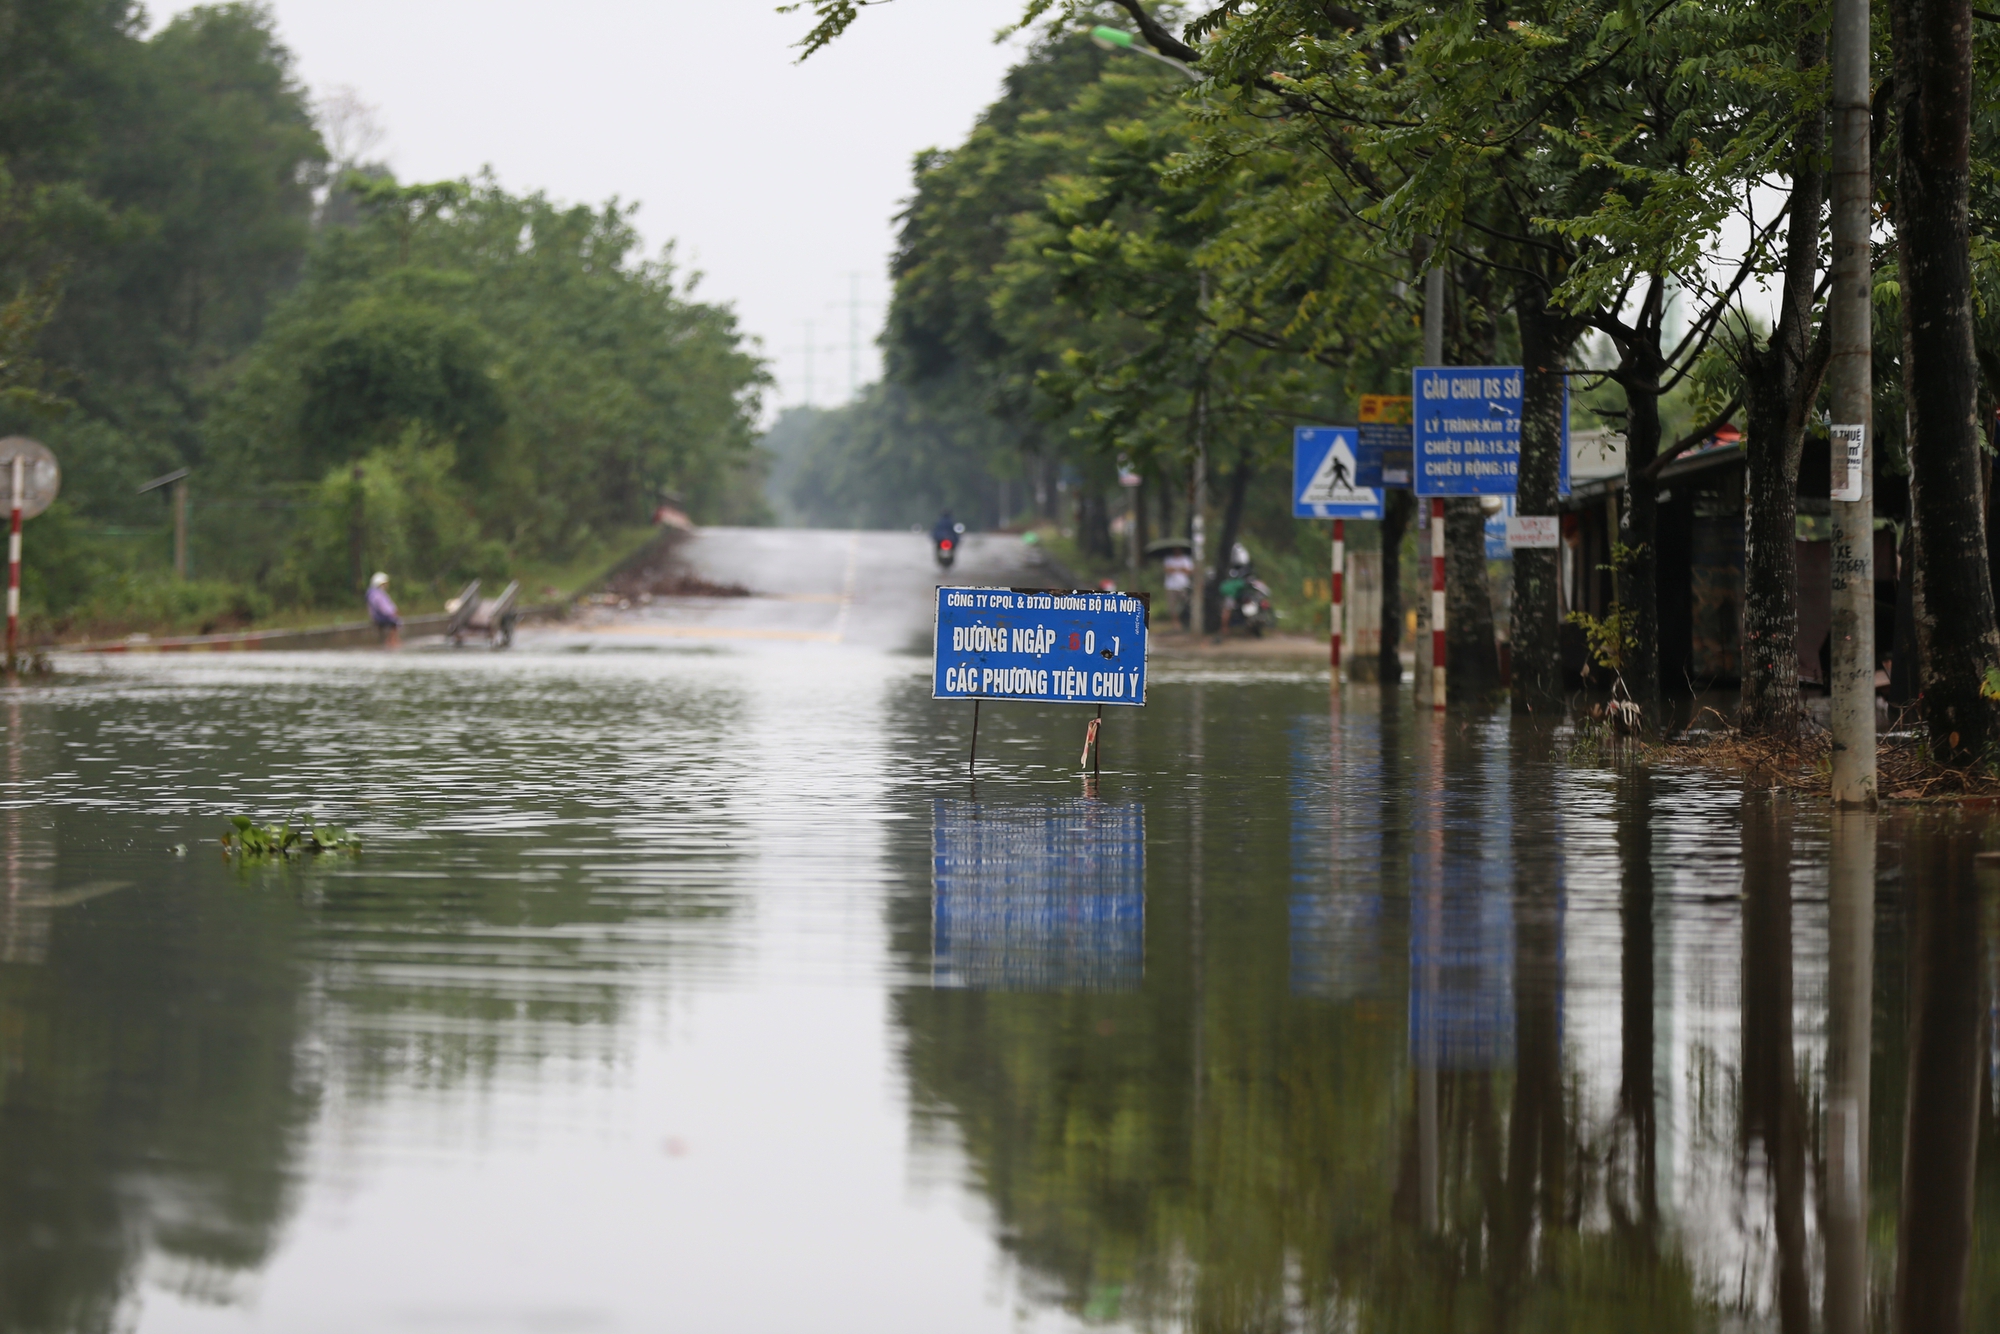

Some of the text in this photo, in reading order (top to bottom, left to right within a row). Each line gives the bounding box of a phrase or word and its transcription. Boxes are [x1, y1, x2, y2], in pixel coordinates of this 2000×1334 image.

[947, 591, 974, 607] CÔNG
[976, 594, 987, 607] TY
[990, 595, 1014, 609] CPQL
[1017, 597, 1025, 608] &
[1026, 597, 1051, 609] ĐTXD
[1088, 597, 1102, 614] BỘ
[1104, 596, 1117, 613] HÀ
[1119, 597, 1137, 615] NỘI
[953, 619, 1007, 651] ĐƯỜNG
[1012, 624, 1057, 658] NGẬP
[946, 662, 1140, 699] CÁC PHƯƠNG TIỆN CHÚ Ý
